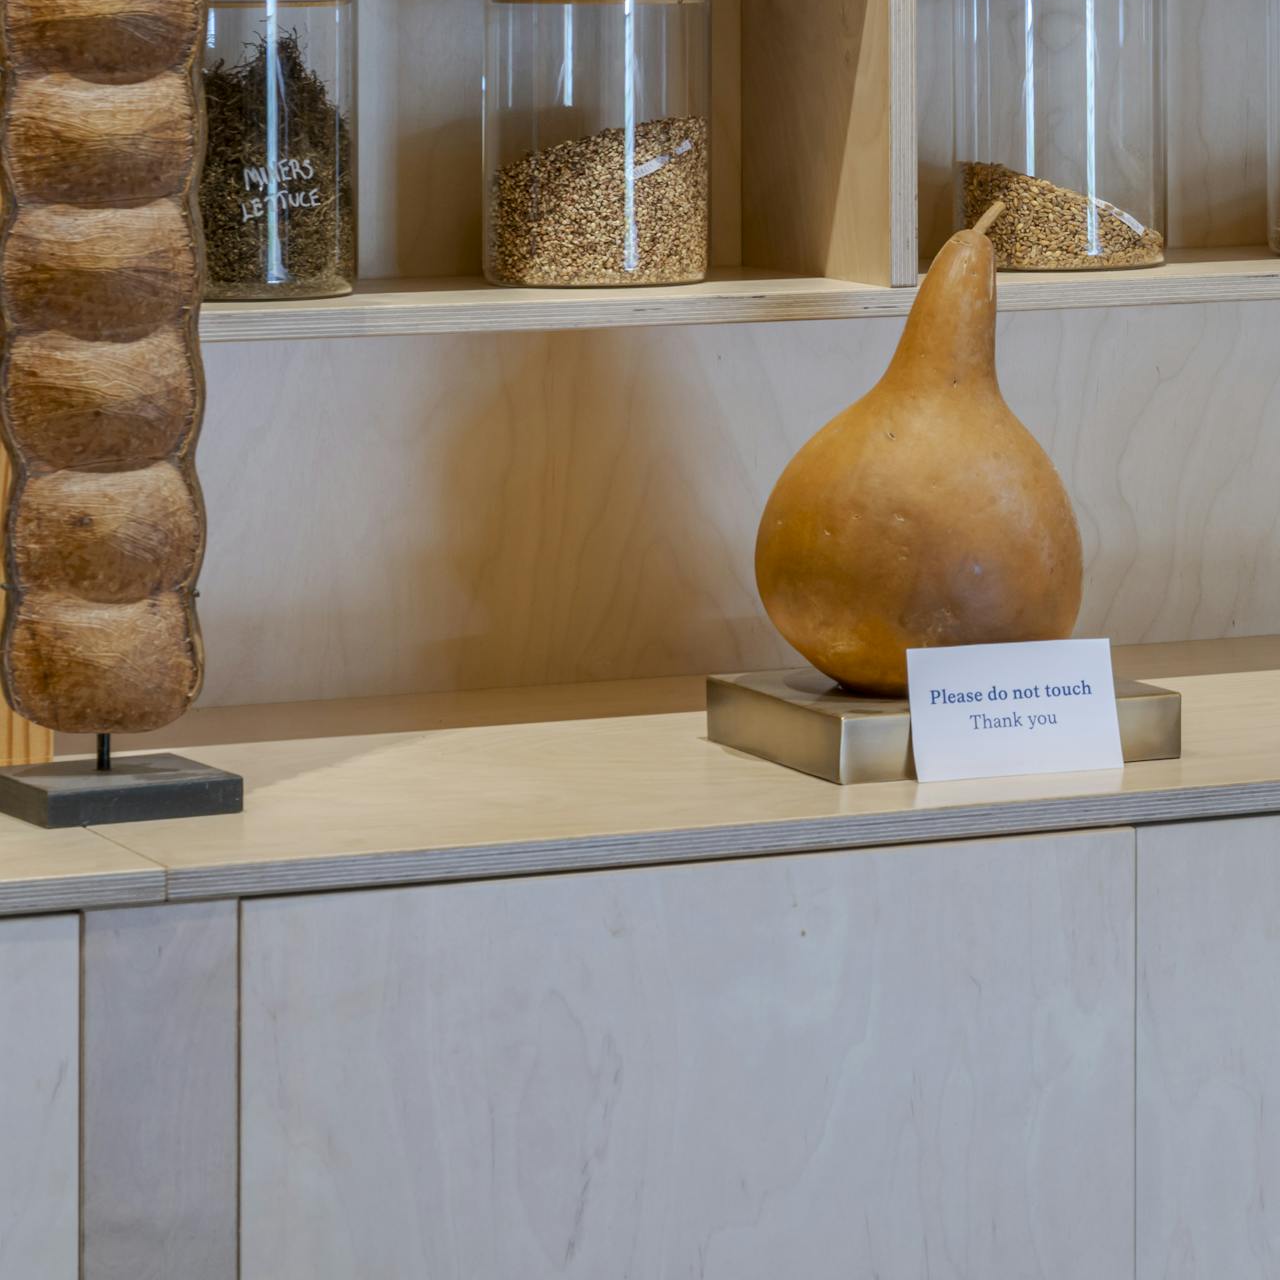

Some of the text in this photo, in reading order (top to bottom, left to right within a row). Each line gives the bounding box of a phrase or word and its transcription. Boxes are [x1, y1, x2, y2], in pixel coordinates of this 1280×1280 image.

[930, 680, 1092, 706] Please do not touch
[970, 711, 1057, 730] Thank you
